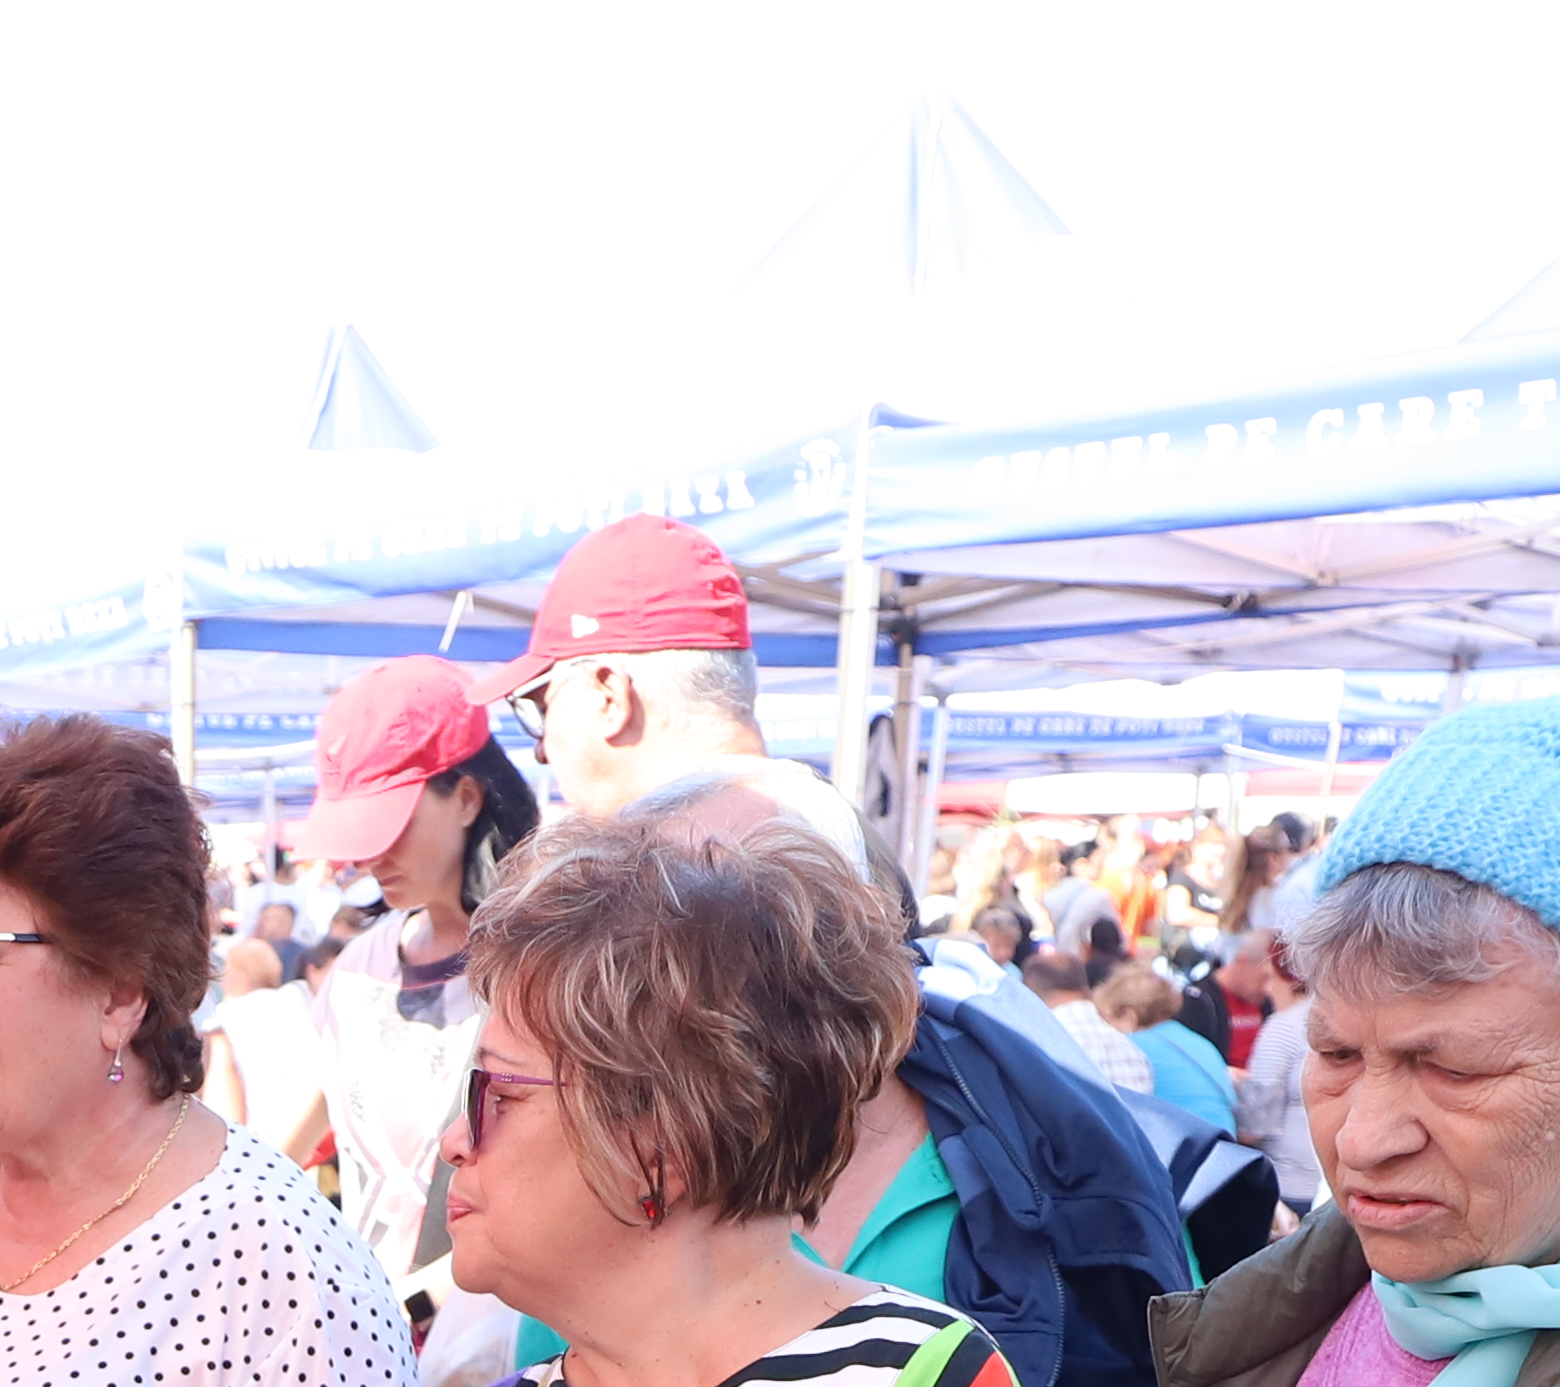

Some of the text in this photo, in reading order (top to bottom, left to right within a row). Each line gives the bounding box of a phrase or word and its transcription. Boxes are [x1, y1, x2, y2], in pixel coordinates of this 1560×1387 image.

[967, 432, 1179, 502] GUSTUL
[1200, 417, 1278, 472] PE
[1304, 389, 1485, 458] CARE
